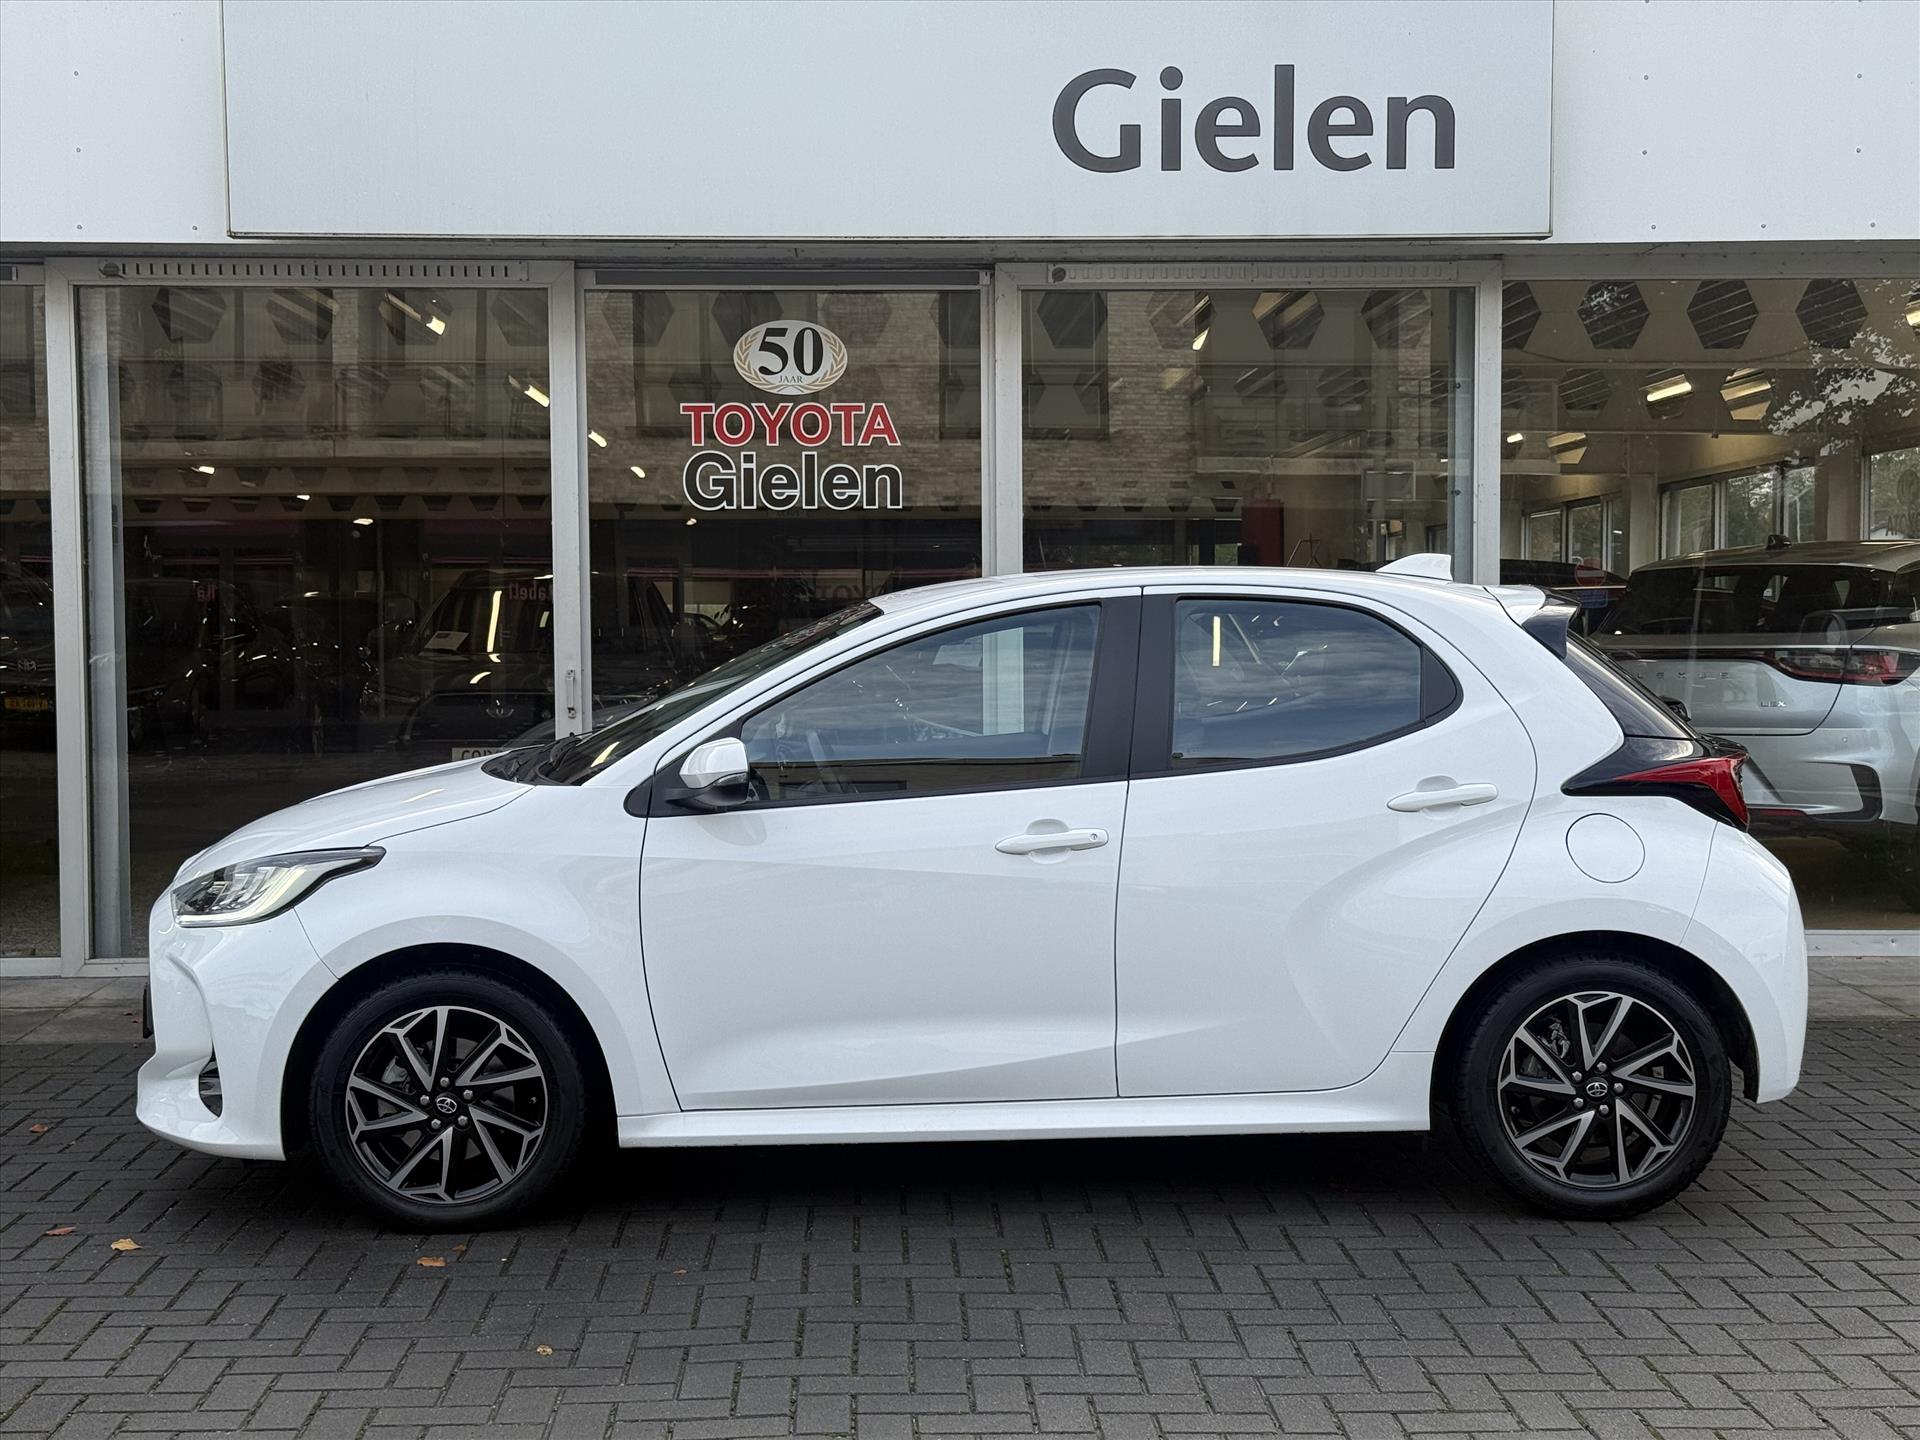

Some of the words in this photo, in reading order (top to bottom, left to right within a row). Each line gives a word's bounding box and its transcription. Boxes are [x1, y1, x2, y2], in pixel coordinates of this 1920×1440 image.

[1052, 64, 1456, 173] Gielen
[758, 326, 824, 376] 50
[778, 375, 804, 384] JAAR
[680, 402, 901, 447] TOYOTA
[683, 450, 903, 511] Gielen
